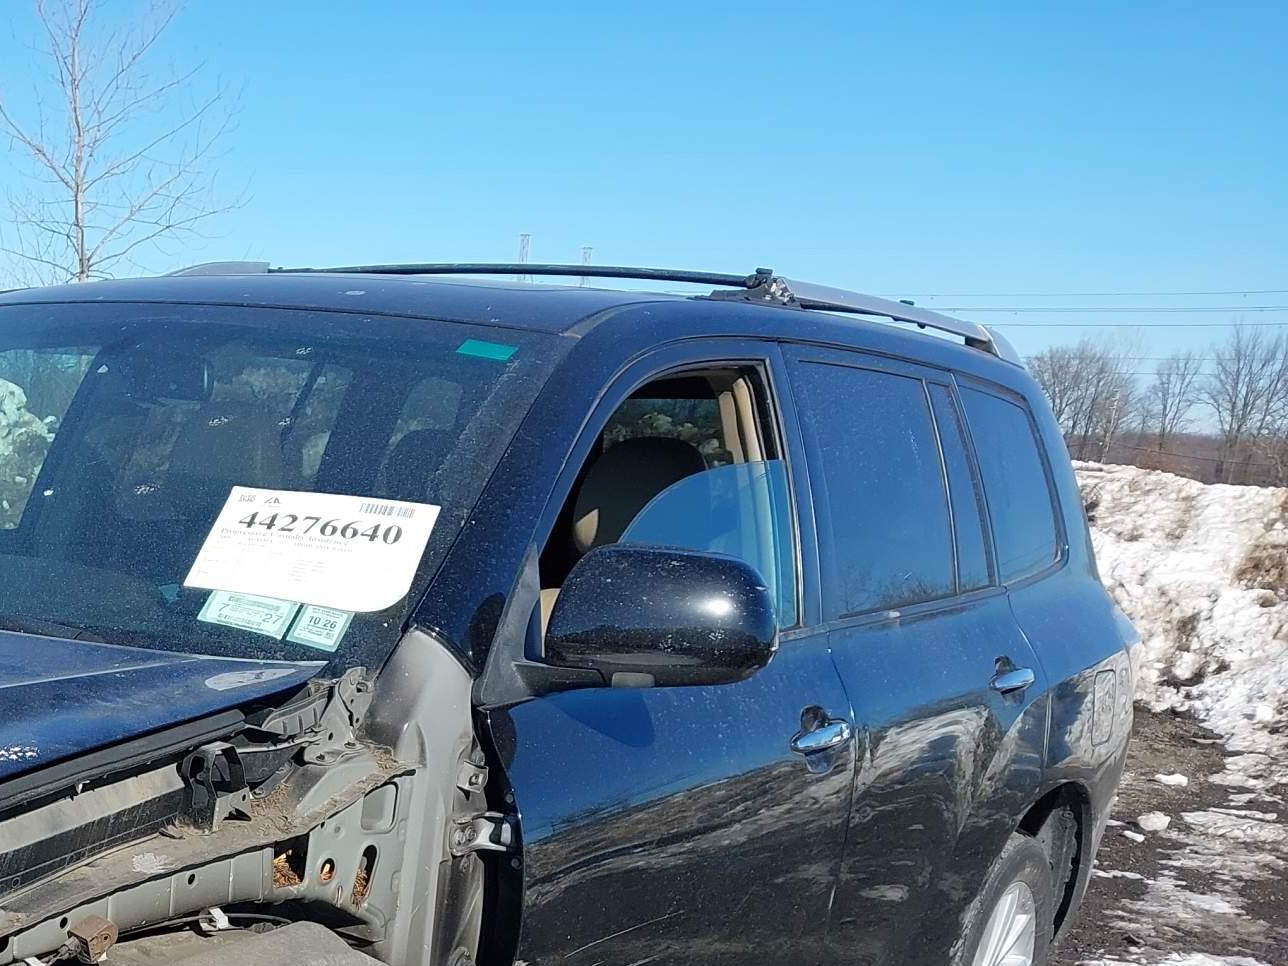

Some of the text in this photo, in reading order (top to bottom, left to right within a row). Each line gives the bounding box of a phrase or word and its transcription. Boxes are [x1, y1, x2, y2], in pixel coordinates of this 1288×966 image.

[237, 510, 403, 545] 44276640
[309, 615, 338, 630] 10 26
